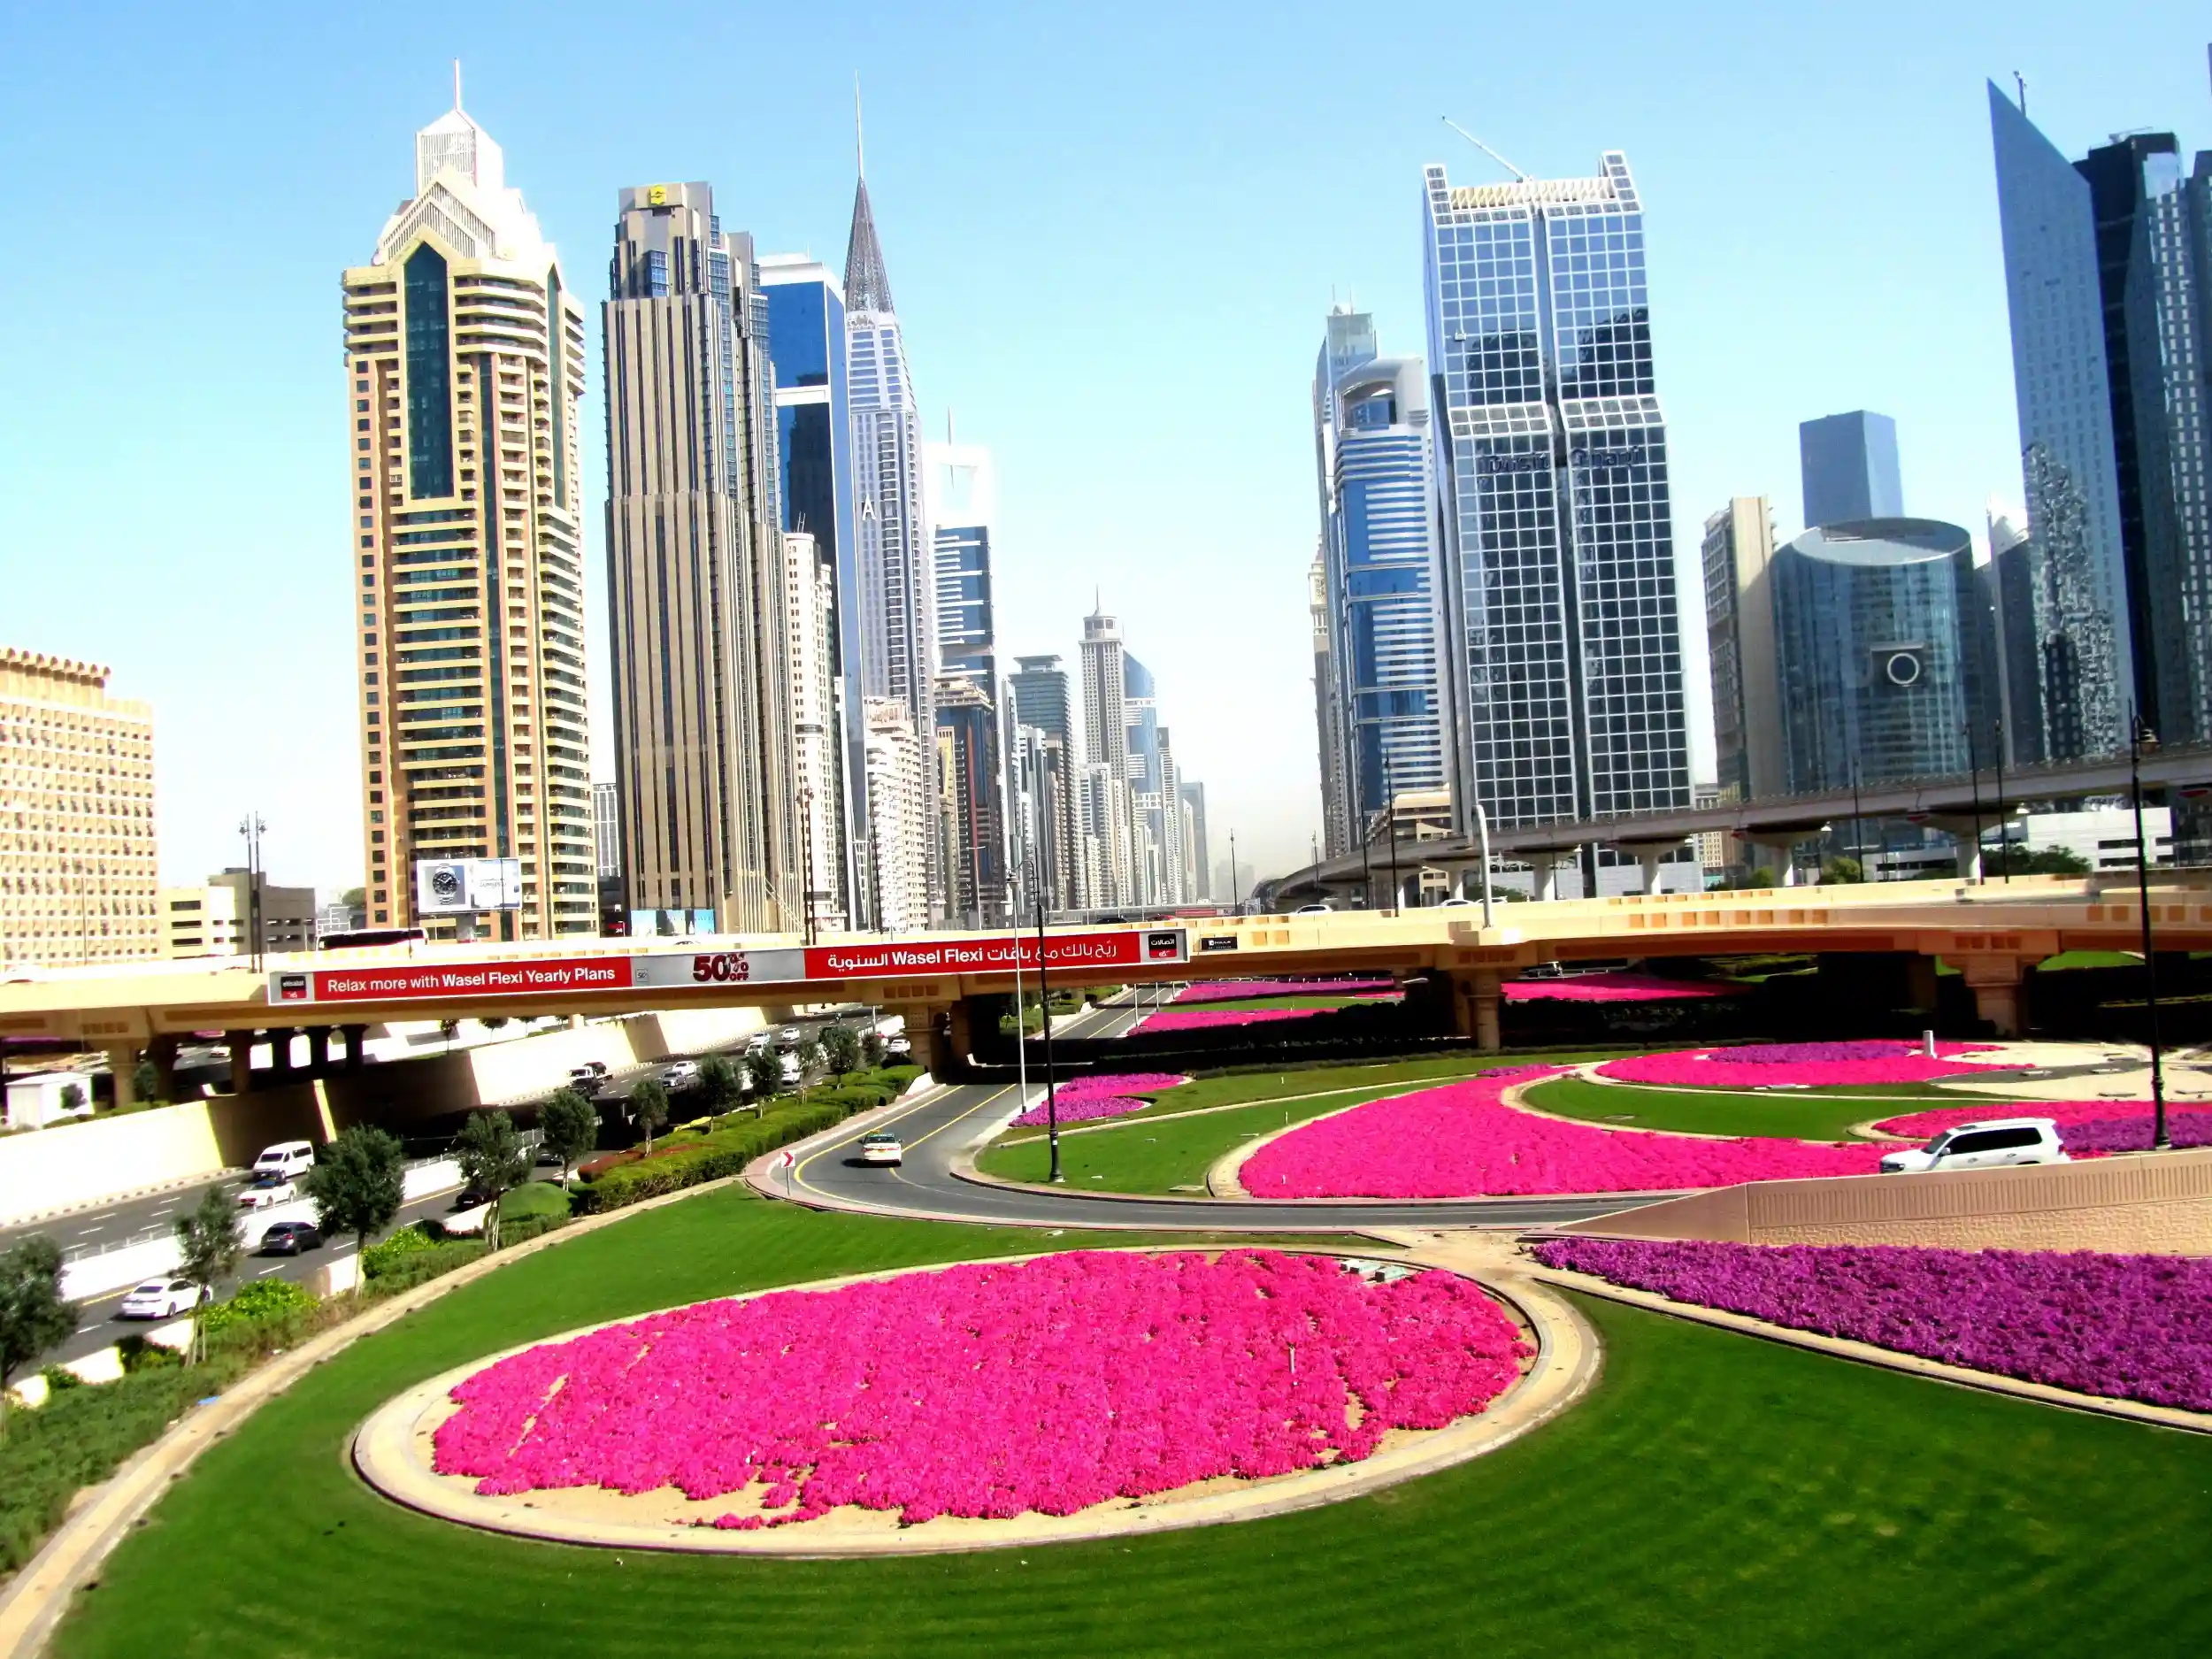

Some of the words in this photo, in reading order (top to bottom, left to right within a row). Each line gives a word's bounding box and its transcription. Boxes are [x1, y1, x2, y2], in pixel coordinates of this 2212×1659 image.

[827, 953, 888, 972] السنوية
[892, 949, 941, 965] Wasel
[944, 947, 983, 964] Flexi
[327, 979, 366, 993] Relax
[370, 978, 407, 990] more
[410, 972, 439, 988] with
[442, 972, 485, 987] Wasel
[488, 970, 523, 985] Flexi
[526, 968, 572, 985] Yearly
[574, 967, 616, 981] Plans
[730, 972, 749, 981] OFF
